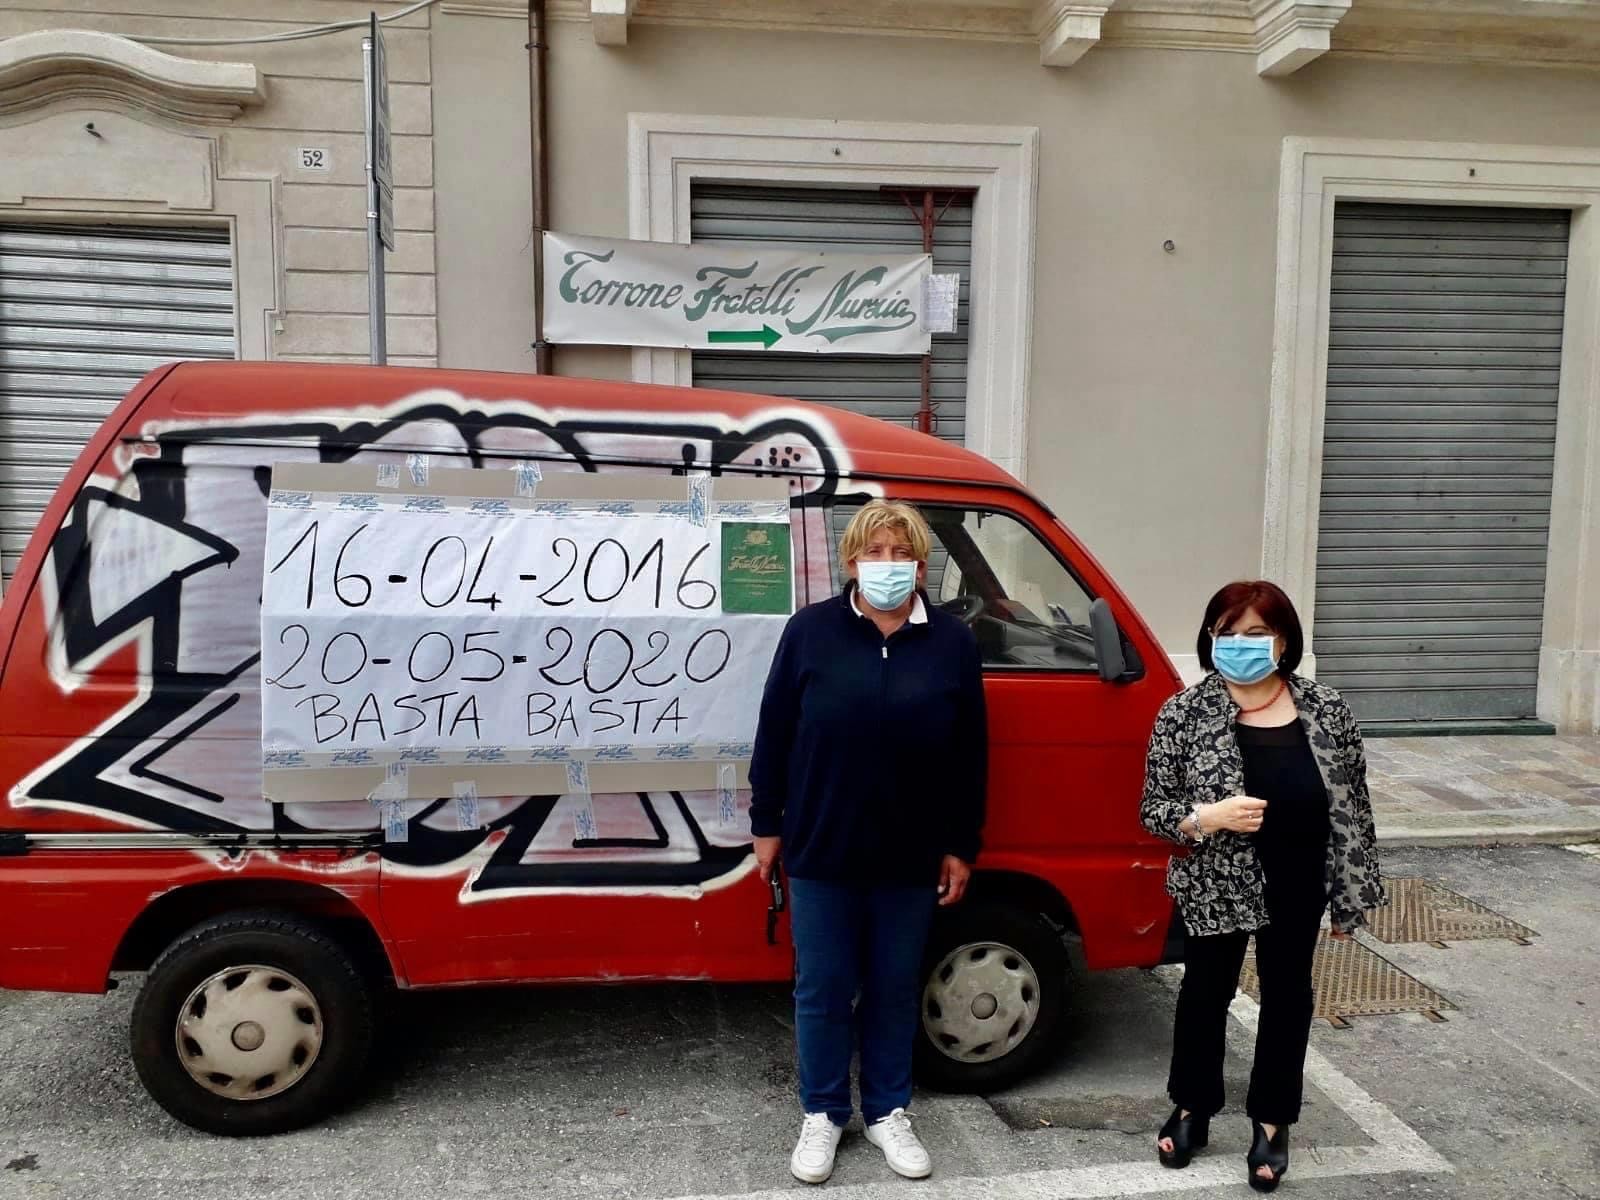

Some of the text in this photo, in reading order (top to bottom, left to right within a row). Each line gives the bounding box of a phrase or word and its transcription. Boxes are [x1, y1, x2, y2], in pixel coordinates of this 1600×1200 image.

[303, 150, 323, 167] 52
[559, 249, 684, 309] Torrone
[683, 261, 820, 321] Fratelli
[786, 265, 916, 344] Nurzia
[271, 520, 717, 611] 16-04-2016
[265, 624, 731, 694] 20-05-2020
[295, 692, 689, 743] BASTA BASTA
